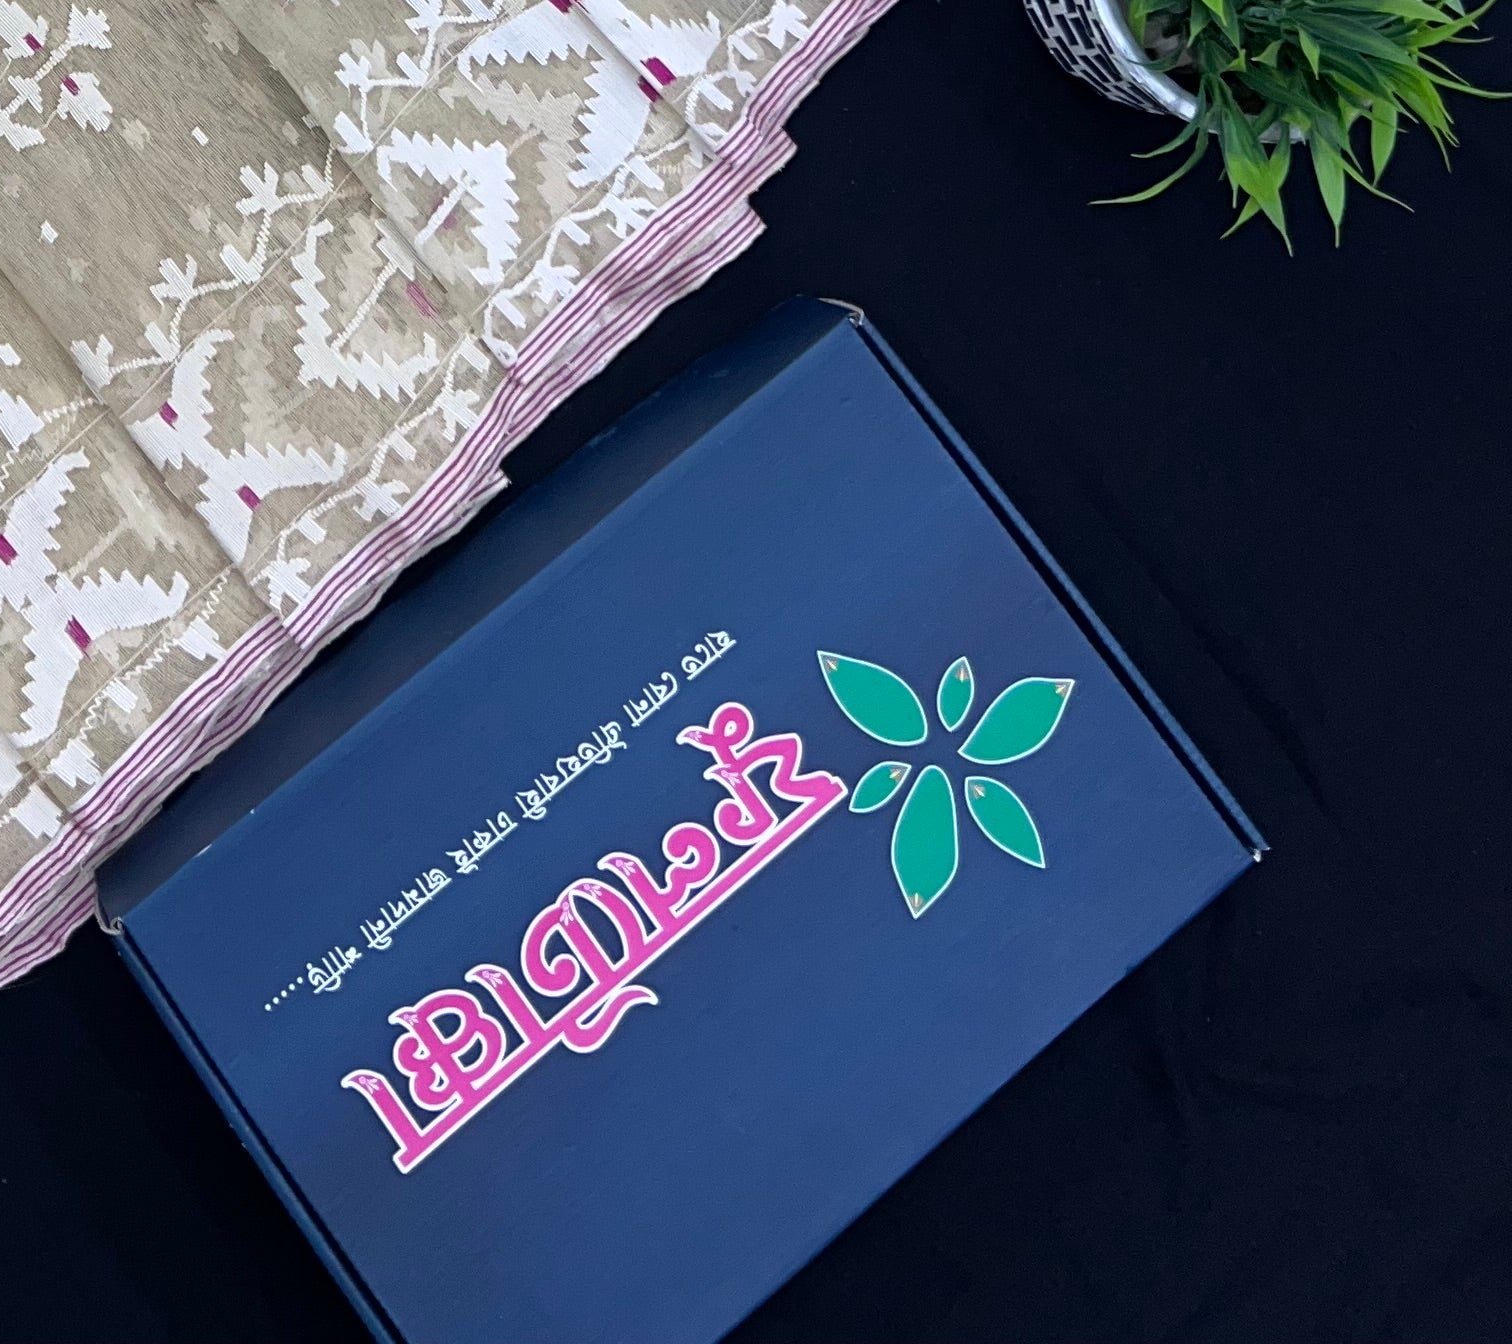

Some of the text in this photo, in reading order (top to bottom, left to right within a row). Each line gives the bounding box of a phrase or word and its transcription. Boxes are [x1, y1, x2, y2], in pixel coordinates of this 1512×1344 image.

[681, 630, 737, 681] হাতে
[622, 671, 678, 728] বোনা
[514, 721, 627, 821] ঐতিহ্যবাহী
[445, 811, 519, 874] ঢাকাই
[340, 701, 849, 1175] ফুলটোক্কা
[359, 868, 452, 950] জামদানী
